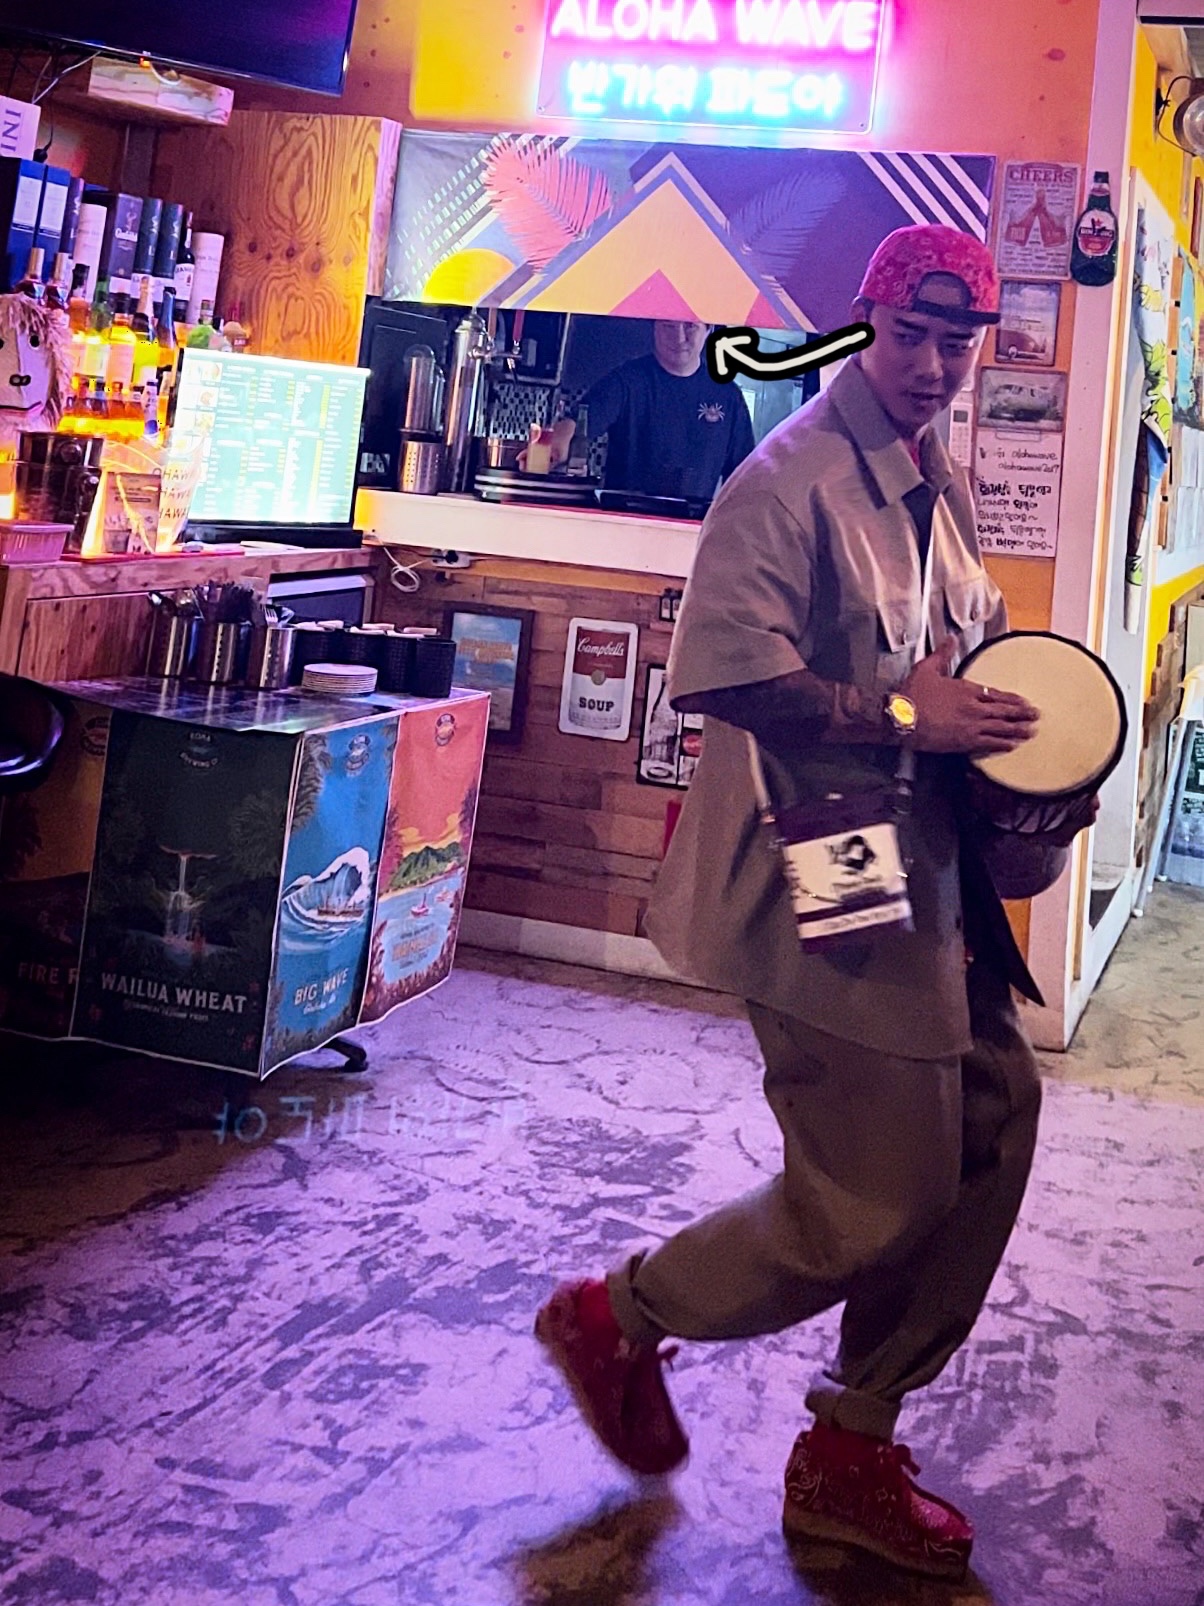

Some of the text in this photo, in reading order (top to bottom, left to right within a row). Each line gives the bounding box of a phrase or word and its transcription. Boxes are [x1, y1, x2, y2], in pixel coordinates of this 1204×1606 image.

[551, 0, 877, 50] ALOHA WAVE
[567, 60, 844, 120] 반가워 파도야
[1009, 168, 1074, 184] CHEERS
[579, 697, 615, 712] SOUP
[18, 961, 59, 984] FIRE
[294, 968, 349, 1005] BIG WAVE
[101, 972, 169, 1004] WAILUA
[175, 987, 247, 1014] WHEAT
